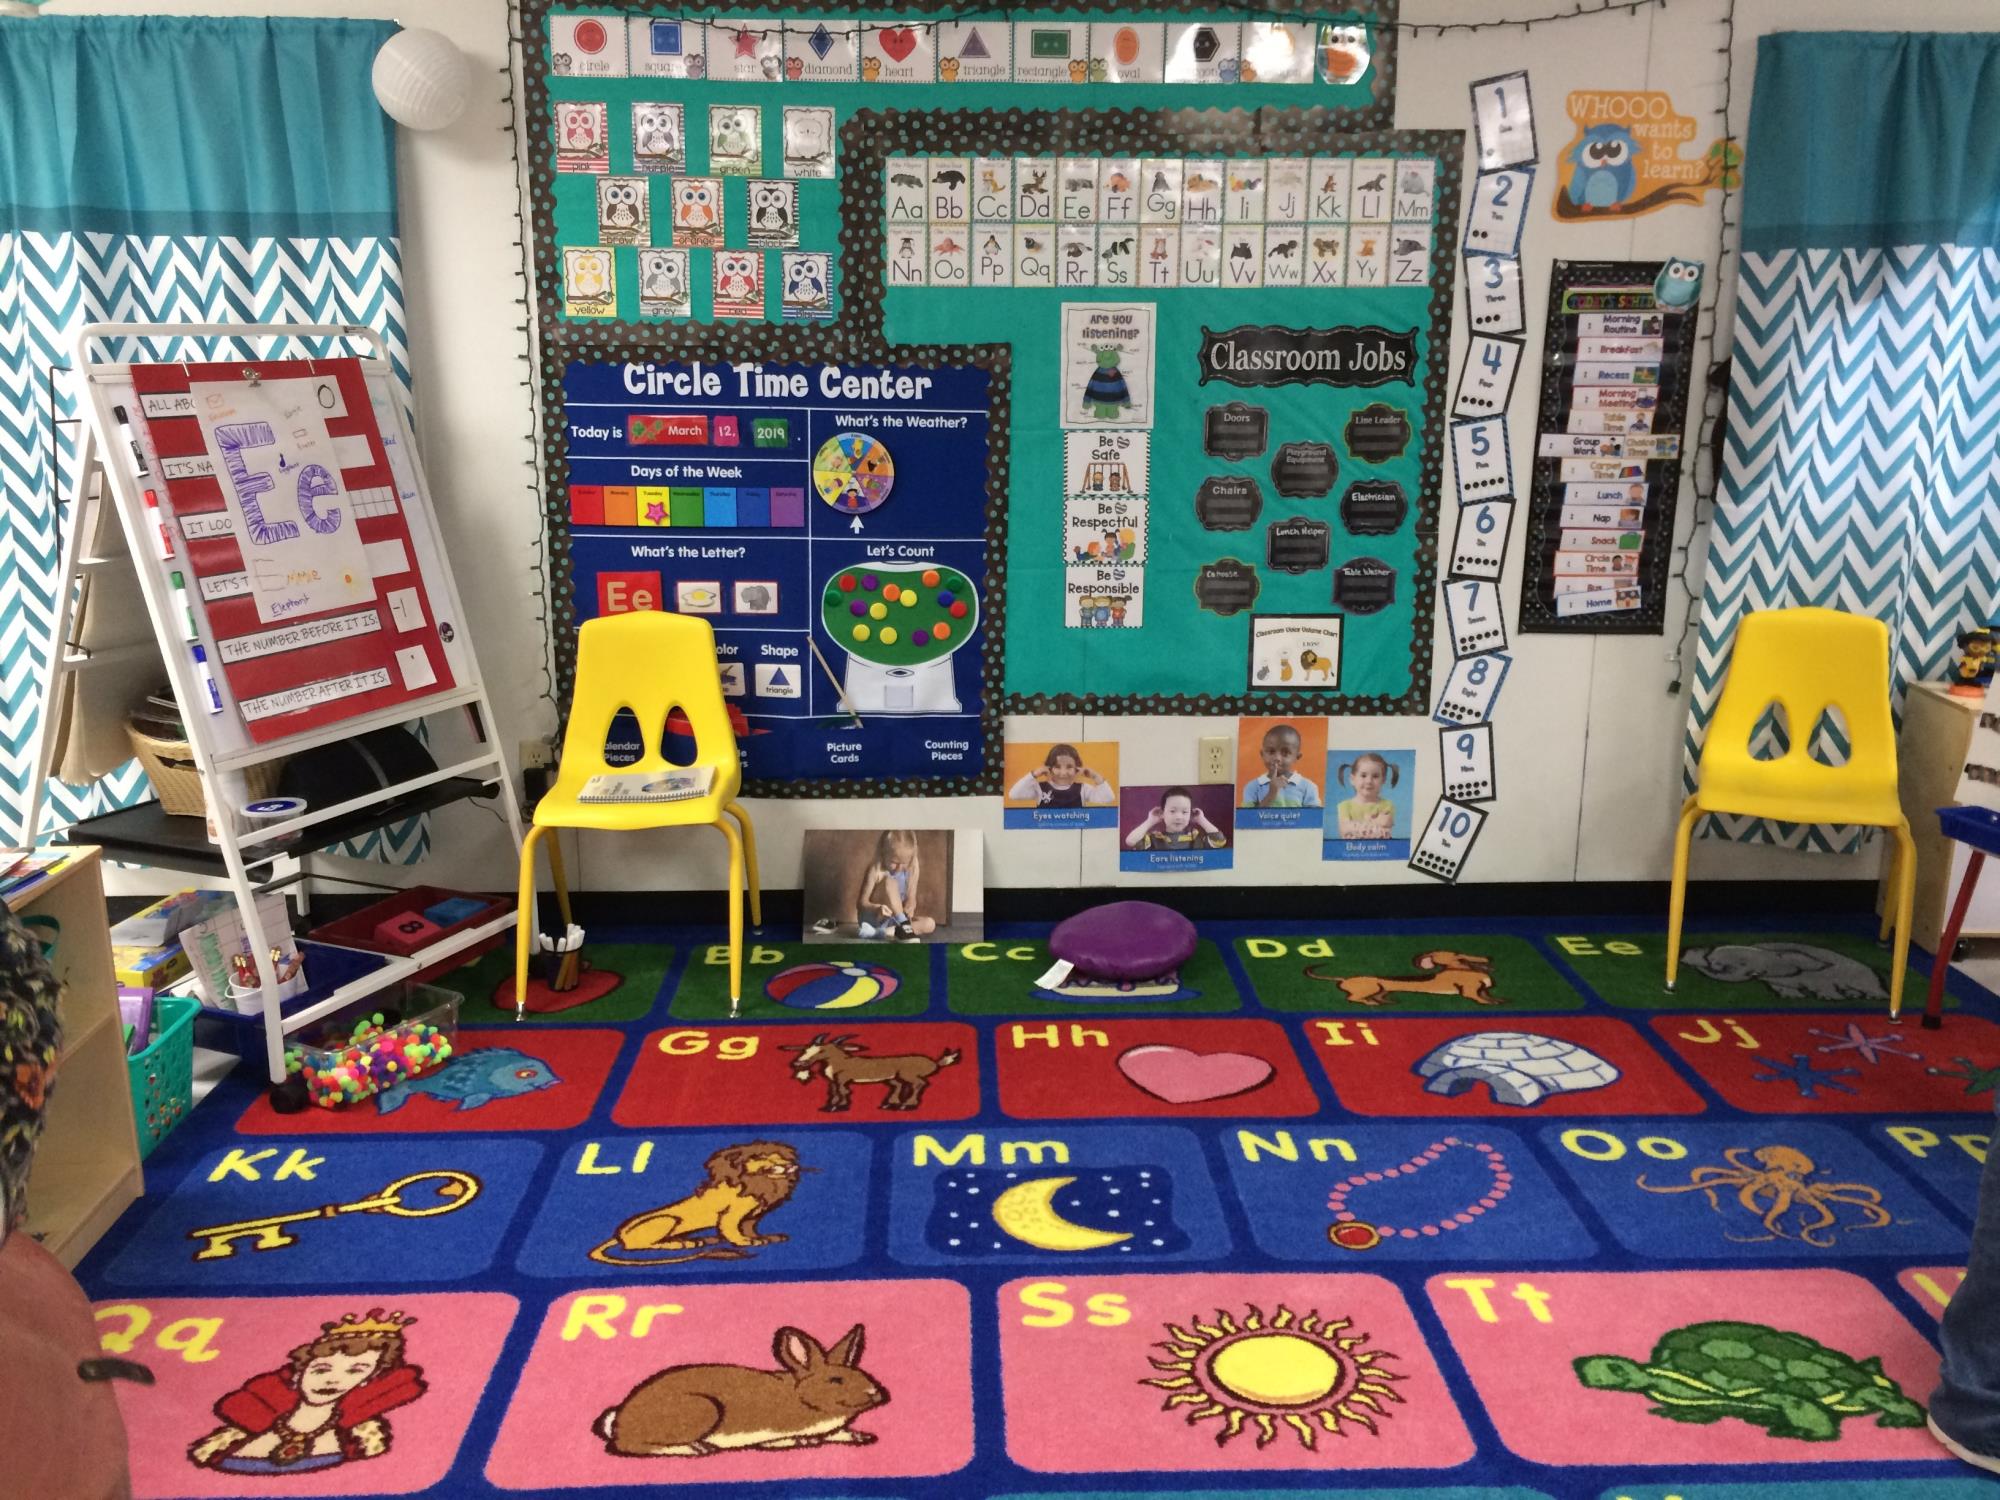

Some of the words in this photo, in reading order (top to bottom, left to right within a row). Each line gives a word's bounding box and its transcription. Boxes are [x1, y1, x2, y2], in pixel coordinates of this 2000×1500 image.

[579, 60, 610, 72] circle
[733, 62, 756, 74] star
[805, 63, 853, 76] diamond
[885, 65, 914, 78] heart
[963, 64, 1006, 78] triangle
[1017, 65, 1067, 78] rectangle
[1494, 86, 1508, 119] 1
[1571, 95, 1668, 118] WHOOO
[1635, 122, 1692, 137] wants
[1652, 142, 1673, 159] to
[719, 166, 750, 176] green
[794, 168, 822, 178] white
[1642, 160, 1704, 179] learn?
[1492, 175, 1513, 208] 2
[892, 196, 923, 219] Aa
[936, 197, 963, 219] Bb
[977, 196, 1008, 218] Cc
[1020, 195, 1050, 218] Dd
[1064, 197, 1091, 219] Ee
[1107, 197, 1133, 219] Ff
[1147, 193, 1175, 219] Gg
[1188, 197, 1216, 220] Hh
[1279, 192, 1296, 219] Jj
[1316, 196, 1342, 218] Kk
[1398, 201, 1428, 217] Mm
[679, 237, 715, 248] orange
[892, 260, 922, 282] Nn
[934, 260, 964, 279] Oo
[981, 257, 1004, 283] Pp
[1021, 257, 1051, 283] Qq
[1066, 262, 1088, 283] Rr
[1107, 262, 1128, 284] Ss
[1148, 262, 1169, 283] Tt
[1185, 260, 1214, 283] Uu
[1230, 262, 1257, 283] Vv
[1268, 264, 1299, 279] Ww
[1313, 261, 1337, 283] Xx
[1356, 260, 1378, 281] Yy
[1396, 260, 1423, 283] Zz
[1484, 257, 1503, 289] 3
[574, 305, 606, 317] yellow
[651, 307, 677, 318] grey
[1603, 314, 1641, 325] Morning
[1211, 341, 1340, 370] Classroom
[1349, 341, 1406, 371] Jobs
[1600, 345, 1643, 354] Breakfast
[1482, 343, 1503, 376] 4
[623, 362, 722, 397] Circle
[733, 362, 809, 398] Time
[819, 366, 932, 400] Center
[1599, 389, 1637, 399] Morning
[149, 398, 174, 412] ALL
[835, 415, 880, 427] What's
[882, 416, 903, 428] the
[905, 416, 967, 429] Weather?
[1224, 413, 1250, 423] Doors
[571, 425, 610, 441] Today
[613, 425, 623, 438] is
[668, 423, 702, 436] March
[757, 427, 786, 441] 2019
[1099, 436, 1113, 447] Be
[1471, 426, 1490, 457] 5
[1573, 437, 1600, 447] Group
[1092, 449, 1121, 461] Safe
[1573, 447, 1597, 455] Work
[165, 463, 195, 477] IT'S
[631, 465, 662, 480] Days
[665, 464, 680, 477] of
[683, 465, 703, 478] the
[706, 465, 743, 479] Week
[215, 421, 341, 545] Ee
[1212, 486, 1248, 495] Chairs
[1597, 490, 1623, 499] Lunch
[1098, 503, 1112, 514] Be
[1072, 516, 1138, 531] Respectful
[1475, 505, 1496, 534] 6
[1593, 514, 1611, 524] Nap
[188, 521, 206, 534] IT
[1591, 536, 1616, 545] Snack
[631, 546, 675, 558] What's
[678, 546, 699, 558] the
[700, 546, 746, 559] Letter?
[867, 545, 896, 557] Let's
[898, 545, 935, 558] Count
[1584, 554, 1611, 563] Circle
[1586, 564, 1607, 572] Time
[1097, 570, 1111, 581] Be
[208, 578, 239, 593] LET'S
[1068, 583, 1139, 597] Responsible
[607, 581, 653, 612] Ee
[1462, 582, 1481, 612] 7
[1586, 599, 1612, 608] Home
[226, 638, 250, 656] THE
[253, 631, 300, 651] NUMBER
[302, 622, 343, 641] BEFORE
[343, 618, 360, 632] IT
[761, 644, 799, 659] Shape
[1467, 658, 1489, 685] 8
[243, 699, 270, 714] THE
[272, 689, 319, 710] NUMBER
[320, 681, 352, 700] AFTER
[353, 677, 369, 690] IT
[765, 686, 794, 697] triangle
[826, 742, 862, 753] Picture
[925, 739, 969, 752] Counting
[1456, 733, 1475, 760] 9
[604, 753, 636, 762] Pieces
[831, 753, 860, 764] Cards
[931, 751, 963, 761] Pieces
[1033, 810, 1052, 821] Eyes
[1054, 811, 1090, 821] watching
[1258, 811, 1279, 820] Voice
[1281, 811, 1301, 822] quiet
[1438, 806, 1471, 839] 10
[1170, 854, 1204, 864] listening
[961, 942, 1036, 962] Cc
[1245, 938, 1335, 960] Dd
[1553, 936, 1644, 957] Ee
[1011, 1024, 1110, 1049] Hh
[1317, 1021, 1380, 1048] Ii
[1679, 1019, 1760, 1049] Jj
[657, 1030, 760, 1060] Gg
[913, 1134, 1071, 1167] Mm
[1237, 1130, 1358, 1162] Nn
[1561, 1128, 1689, 1161] Oo
[207, 1148, 325, 1182] Kk
[576, 1142, 655, 1175] Ll
[1018, 1281, 1134, 1328] Ss
[1445, 1276, 1554, 1324] Tt
[560, 1295, 685, 1341] Rr
